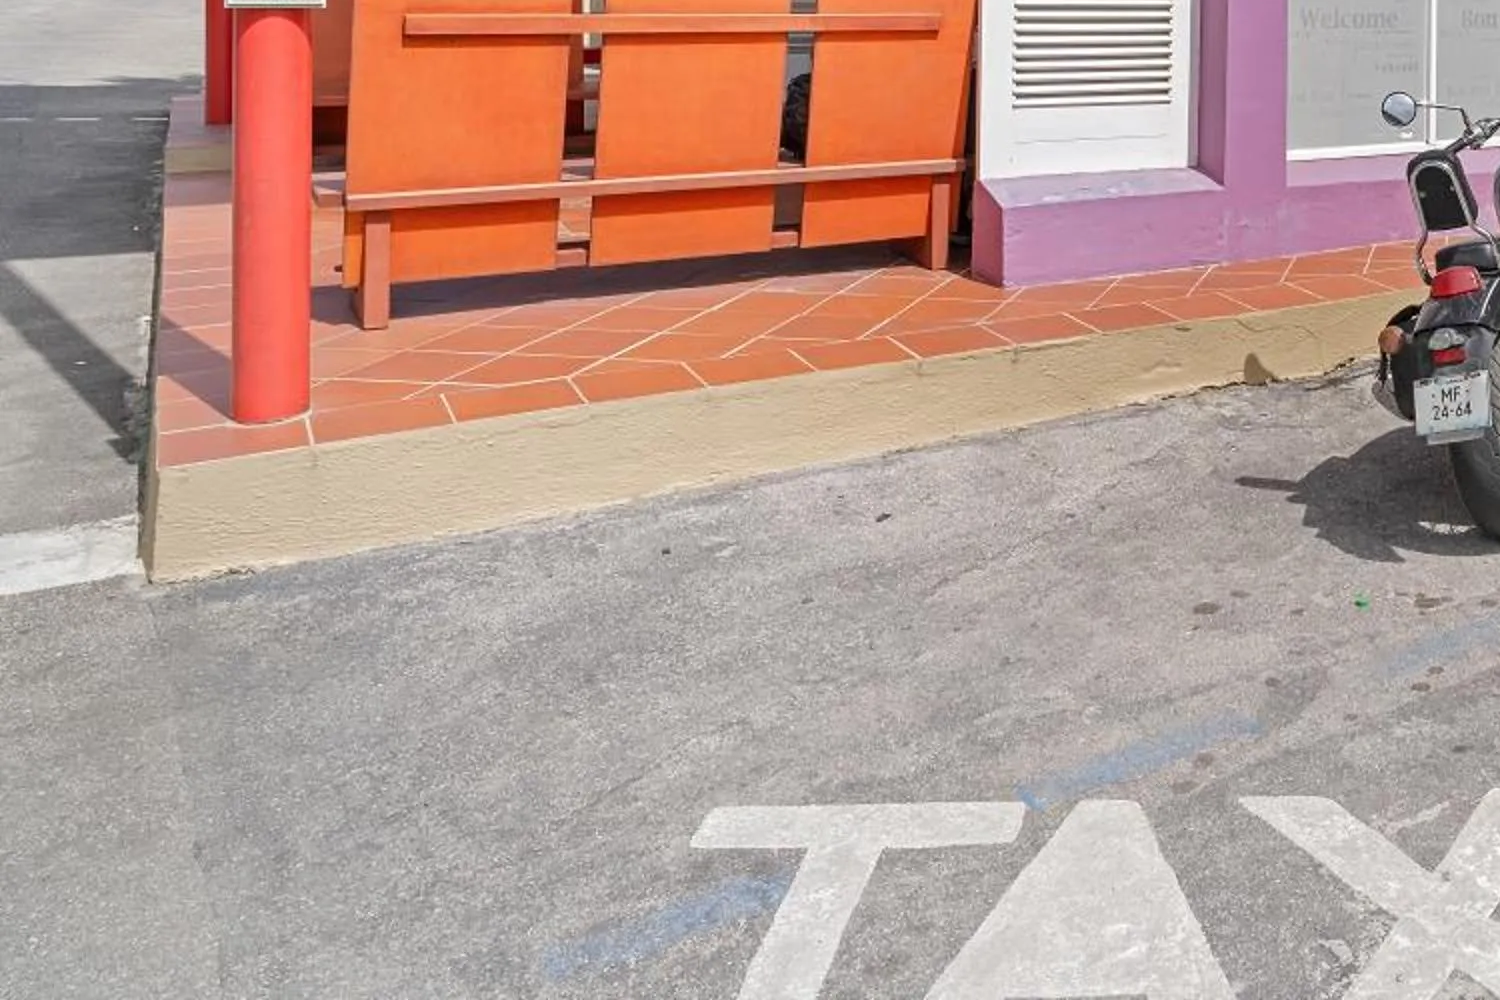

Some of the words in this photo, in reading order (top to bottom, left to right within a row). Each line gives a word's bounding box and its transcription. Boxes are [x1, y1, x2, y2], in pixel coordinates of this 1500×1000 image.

[1299, 6, 1400, 29] Welcome
[1460, 8, 1499, 29] Bon
[1441, 385, 1461, 402] MF
[1431, 401, 1473, 421] 24-64
